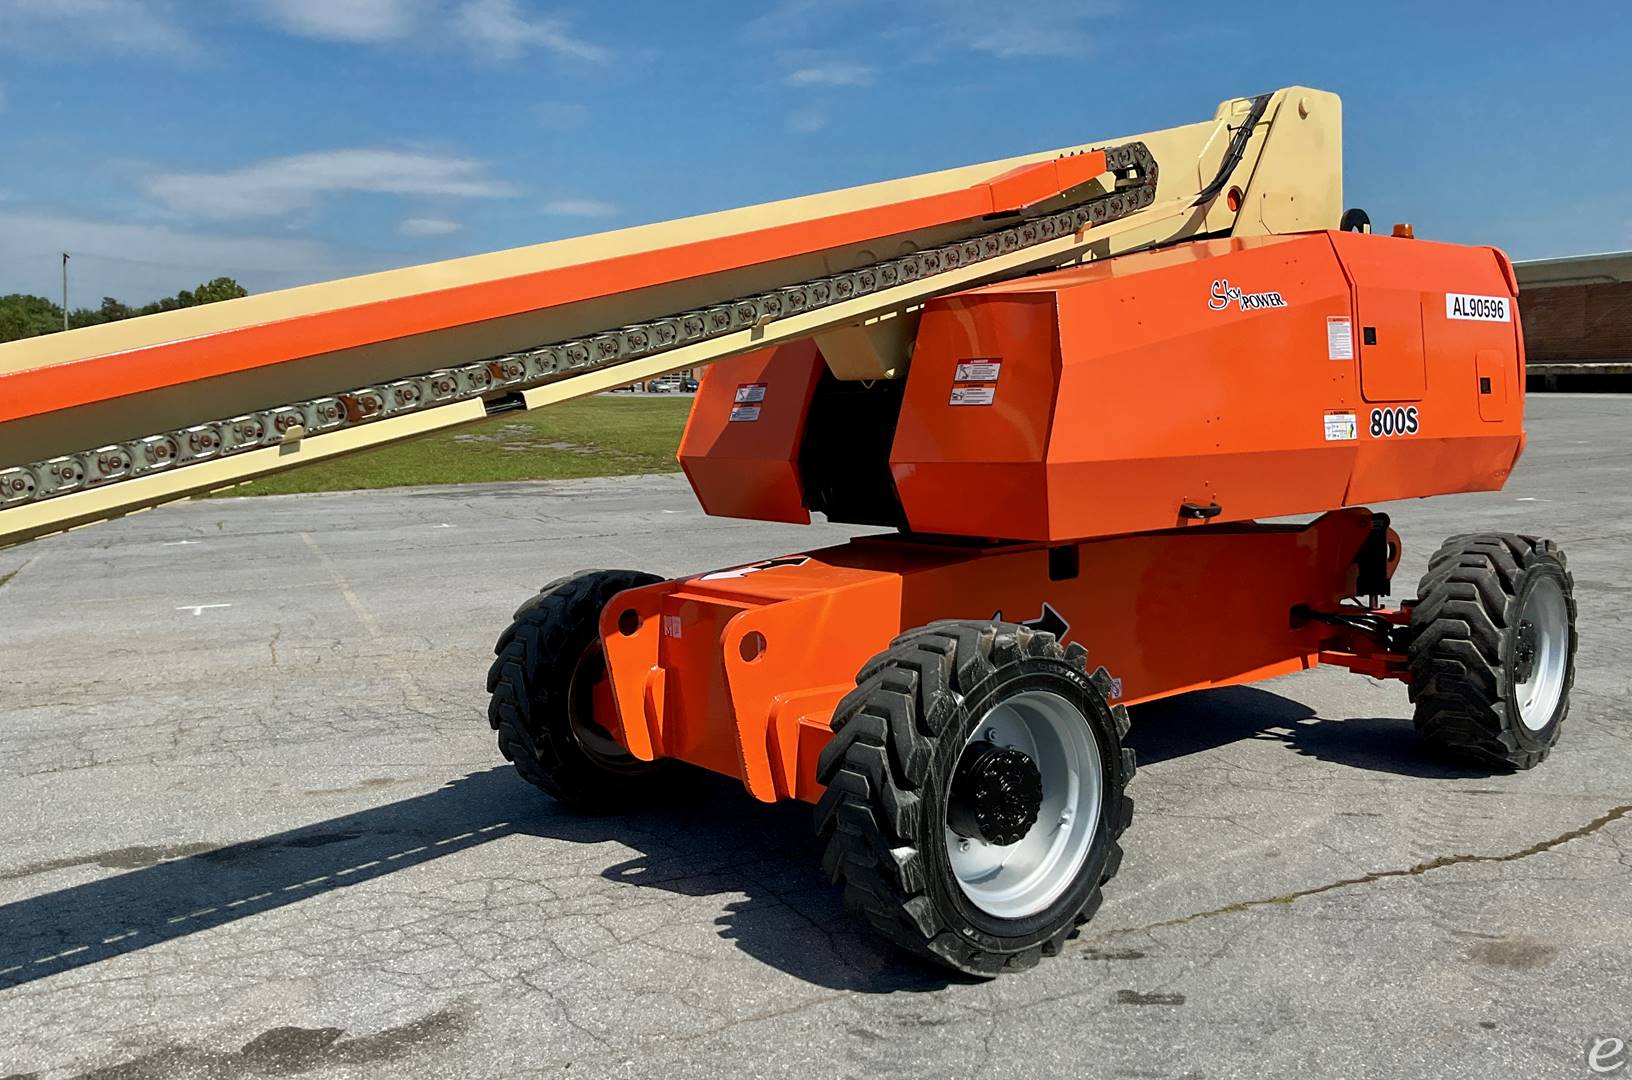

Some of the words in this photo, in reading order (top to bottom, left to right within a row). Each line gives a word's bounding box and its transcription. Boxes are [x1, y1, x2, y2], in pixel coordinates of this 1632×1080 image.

[1209, 279, 1243, 311] Sky
[1241, 293, 1285, 310] POWER
[1453, 296, 1504, 319] AL90596
[1370, 406, 1418, 437] 800S
